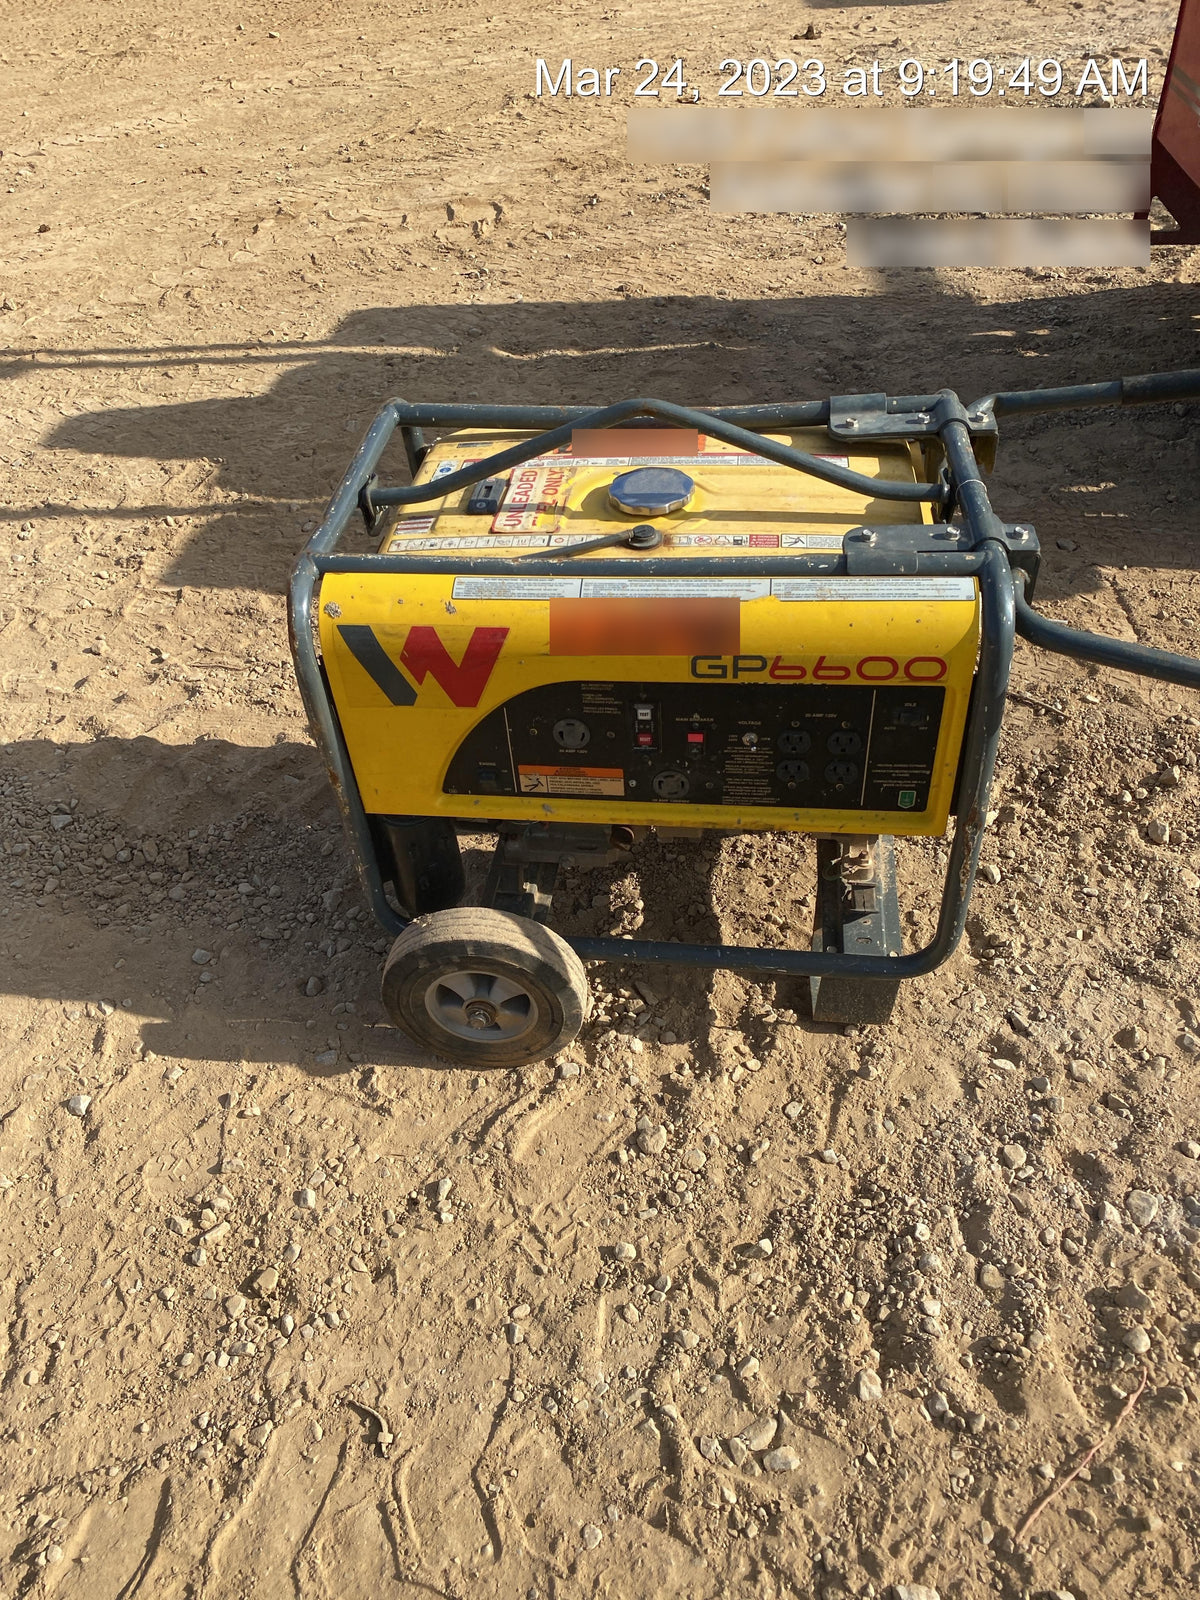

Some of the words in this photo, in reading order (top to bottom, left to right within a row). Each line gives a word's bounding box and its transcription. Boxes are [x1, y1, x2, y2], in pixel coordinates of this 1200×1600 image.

[542, 467, 565, 496] ONLY
[503, 469, 539, 527] UNLEADED
[691, 655, 948, 682] GP6600
